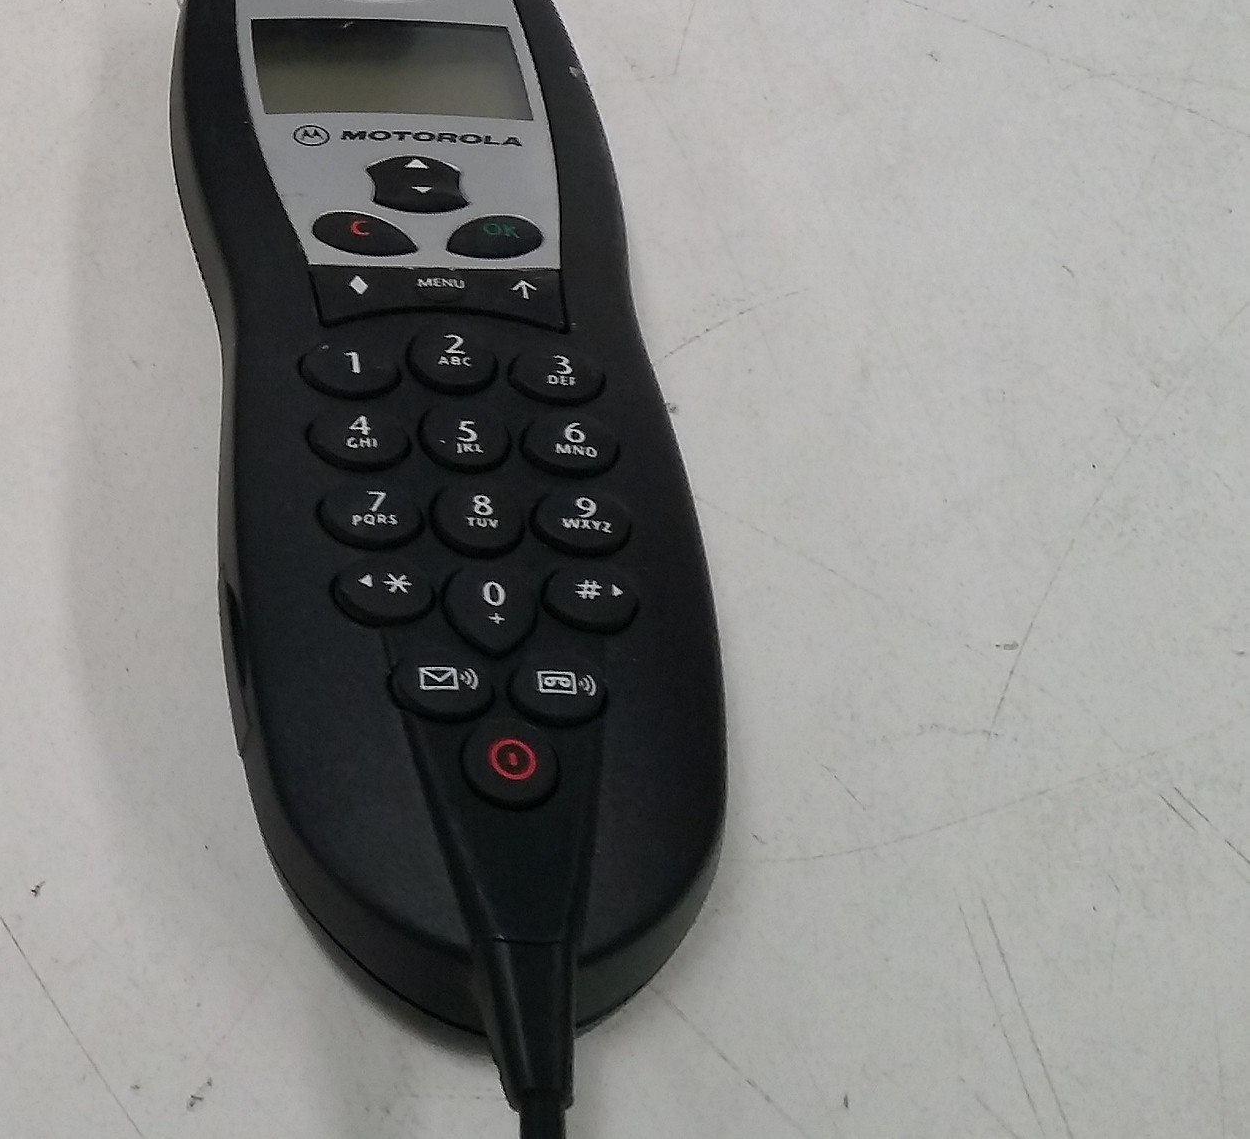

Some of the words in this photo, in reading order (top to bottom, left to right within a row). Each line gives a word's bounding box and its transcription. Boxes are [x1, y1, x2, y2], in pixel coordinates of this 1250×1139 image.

[340, 130, 523, 147] MOTOROLA
[350, 220, 371, 237] C
[482, 221, 520, 239] OK
[417, 277, 465, 289] MENU
[443, 334, 466, 355] 2
[343, 351, 361, 374] 1
[437, 355, 471, 367] ABC
[552, 355, 573, 375] 3
[546, 374, 577, 386] DEF
[348, 415, 371, 436] 4
[457, 420, 478, 443] 5
[564, 422, 586, 443] 6
[345, 436, 378, 449] GHI
[456, 442, 484, 454] JKL
[555, 443, 598, 458] MNO
[366, 490, 387, 513] 7
[472, 494, 494, 516] 8
[575, 496, 597, 519] 9
[351, 513, 398, 526] PQRS
[466, 516, 499, 529] TUV
[562, 517, 612, 534] WXYZ
[482, 580, 506, 607] 0
